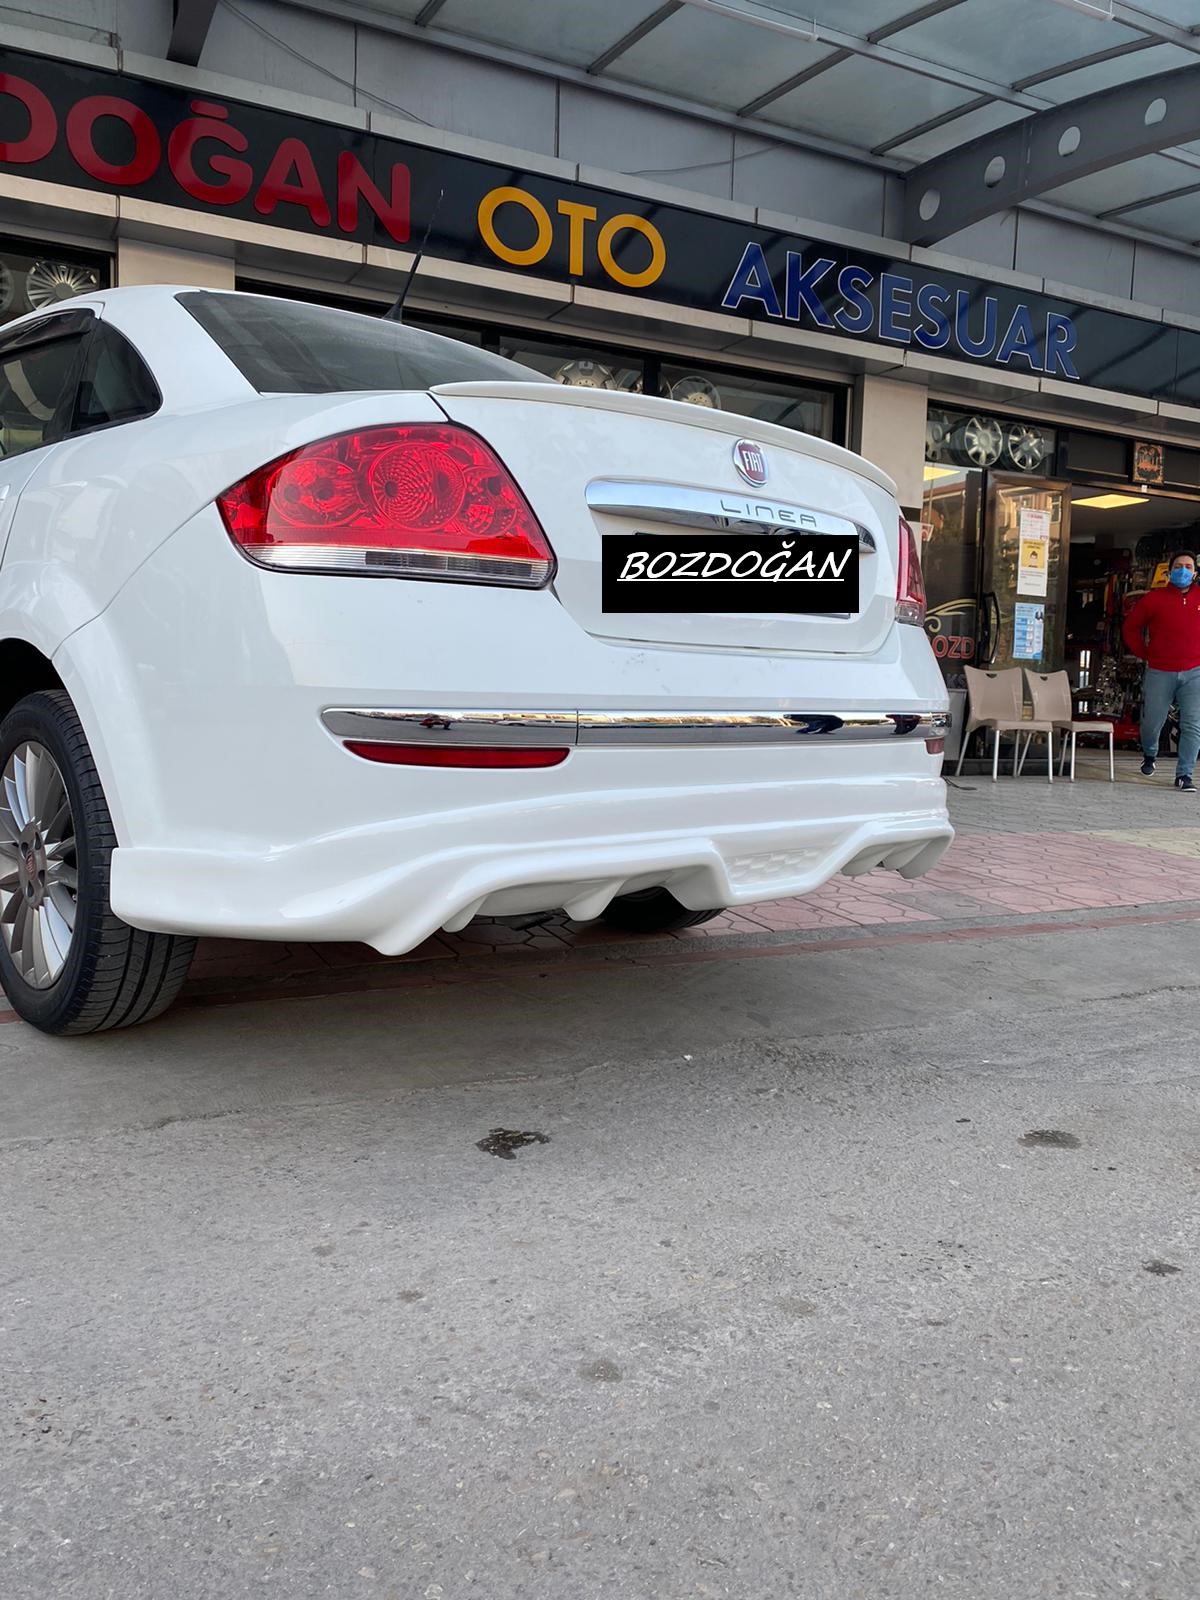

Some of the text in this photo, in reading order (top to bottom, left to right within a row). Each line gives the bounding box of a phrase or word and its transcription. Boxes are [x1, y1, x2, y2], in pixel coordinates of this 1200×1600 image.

[478, 186, 667, 288] OTO
[721, 241, 1081, 380] AKSESUAR
[742, 450, 764, 473] FIAT
[720, 499, 817, 527] LINEA
